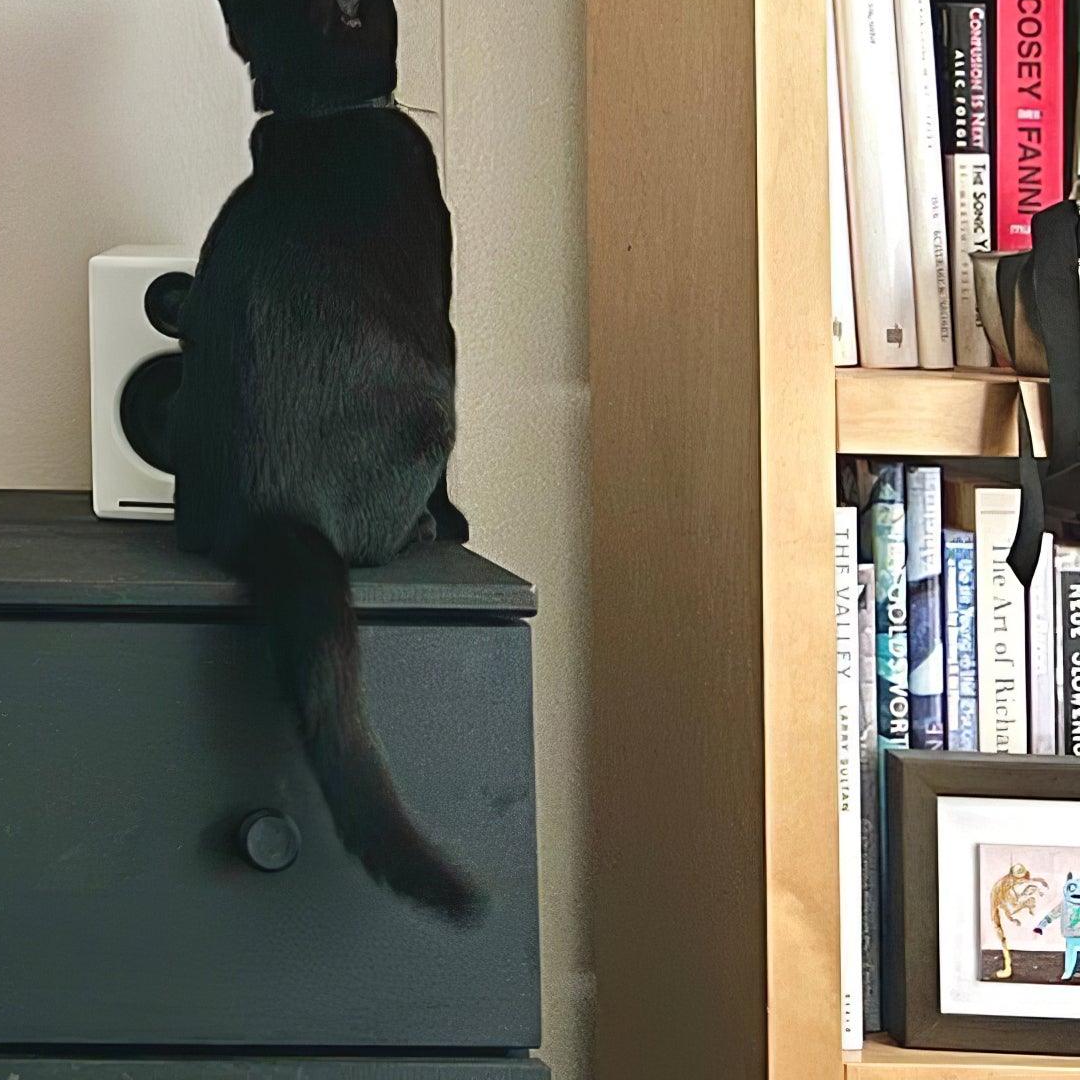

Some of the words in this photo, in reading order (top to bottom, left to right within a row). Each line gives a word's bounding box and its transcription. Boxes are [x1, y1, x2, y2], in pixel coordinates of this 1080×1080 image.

[835, 528, 849, 574] THE
[835, 587, 851, 679] VALLEY
[993, 596, 1013, 633] Art
[888, 585, 909, 750] GOLDSWORT
[993, 642, 1014, 668] of
